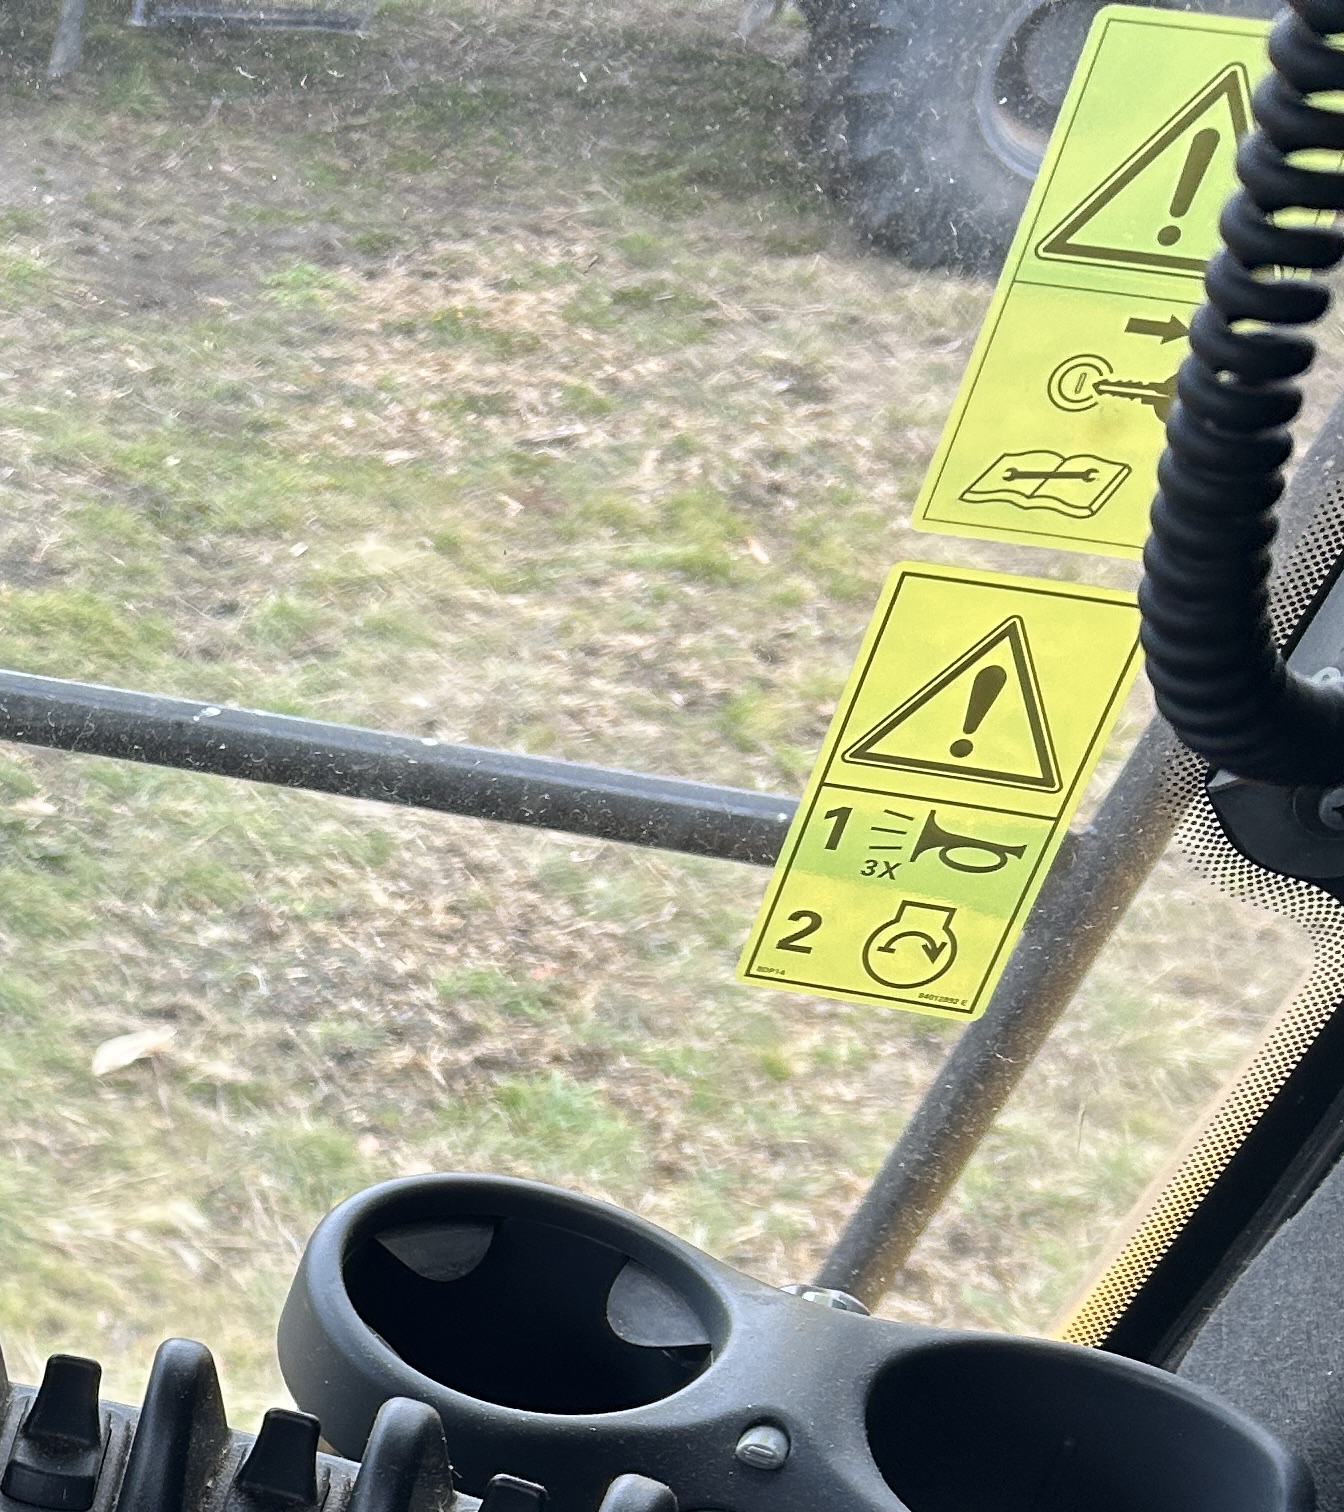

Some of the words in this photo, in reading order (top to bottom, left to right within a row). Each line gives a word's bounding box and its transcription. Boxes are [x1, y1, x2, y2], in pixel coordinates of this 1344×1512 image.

[823, 806, 854, 851] 1
[860, 859, 902, 881] 3X
[775, 909, 823, 954] 2
